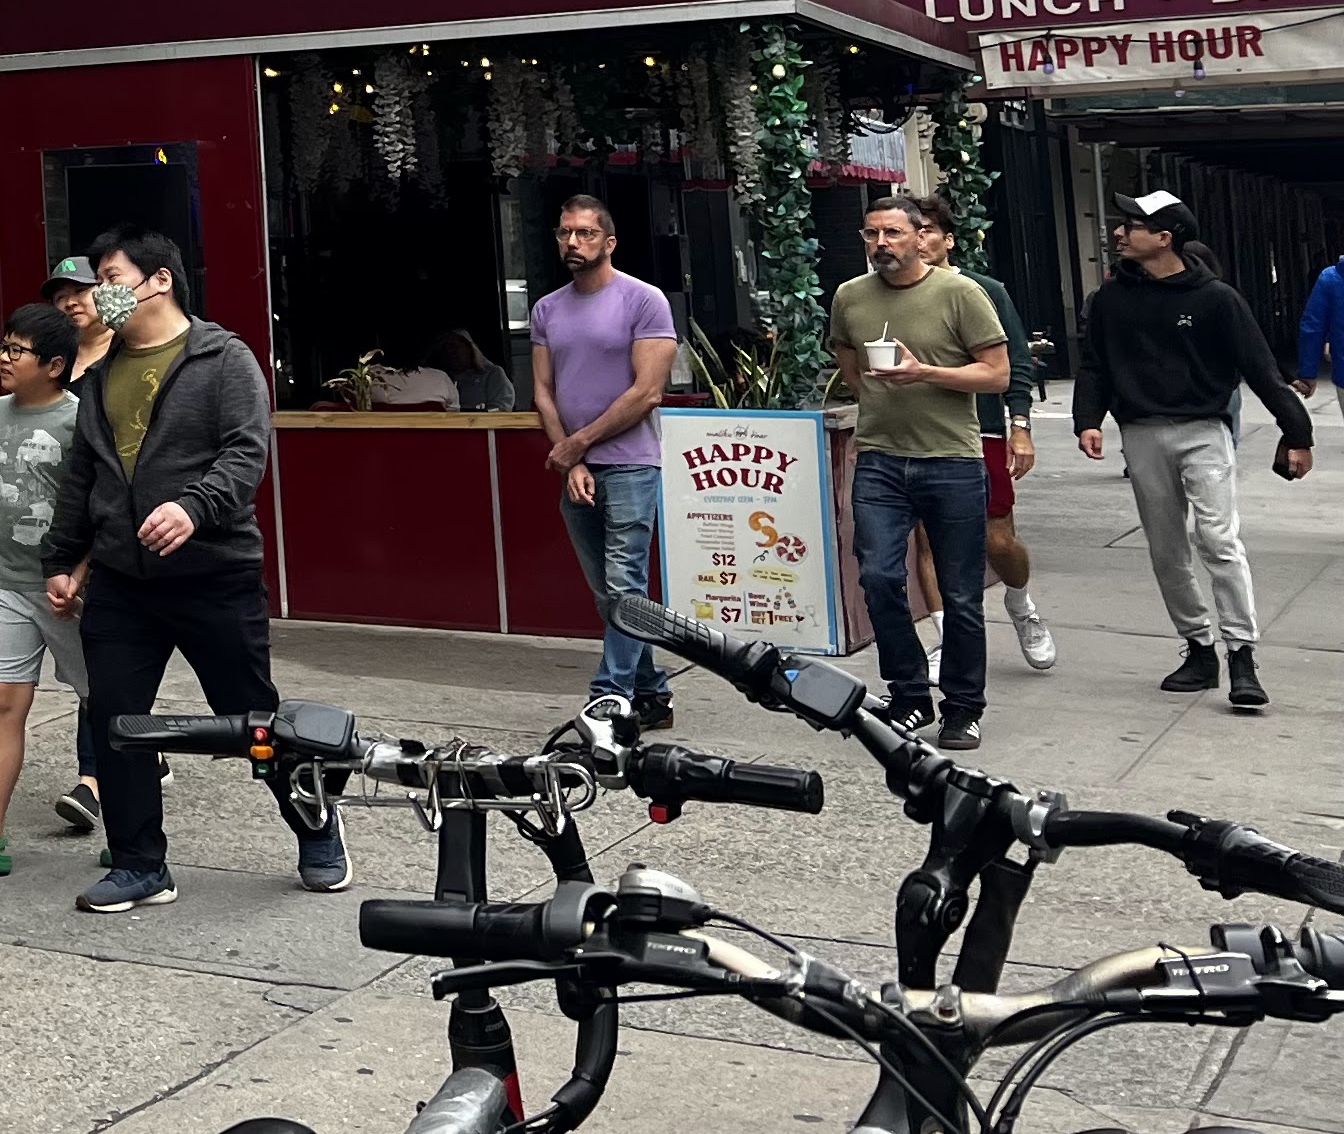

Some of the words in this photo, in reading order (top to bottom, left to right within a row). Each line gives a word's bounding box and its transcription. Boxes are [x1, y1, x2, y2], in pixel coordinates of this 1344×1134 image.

[999, 33, 1132, 72] HAPPY
[1149, 25, 1264, 64] HOUR
[682, 443, 798, 473] HAPPY
[690, 467, 786, 495] HOUR
[687, 512, 733, 521] APPETIZERS
[712, 552, 737, 567] $12
[698, 575, 716, 583] RAIL
[719, 571, 737, 585] $7
[705, 594, 742, 603] Margarita
[720, 606, 742, 623] $7
[1172, 964, 1230, 976] TETRO
